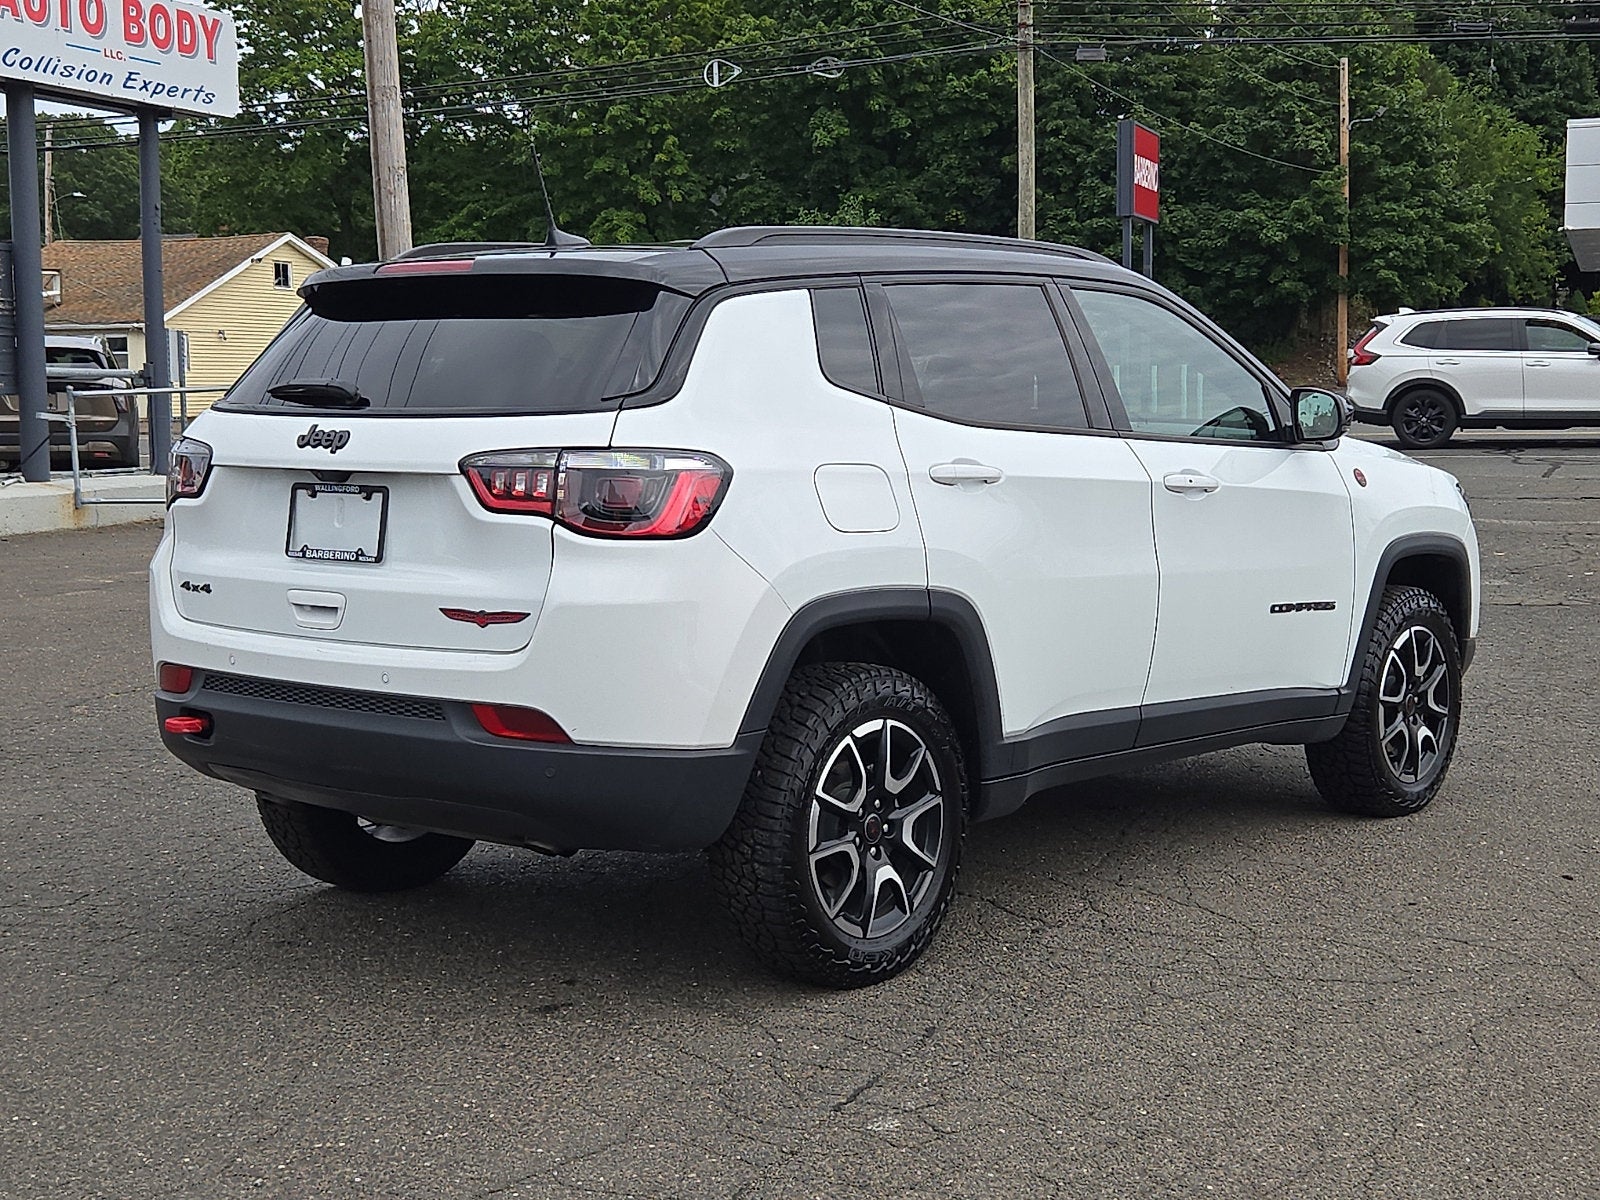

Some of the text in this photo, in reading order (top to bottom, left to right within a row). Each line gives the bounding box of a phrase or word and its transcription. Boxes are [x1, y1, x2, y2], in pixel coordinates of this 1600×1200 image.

[122, 0, 222, 64] BODY
[2, 47, 216, 104] Collision Experts
[1134, 153, 1158, 192] BARBERINO
[297, 424, 350, 454] Jeep
[305, 550, 357, 561] BARBERINO
[180, 580, 212, 594] 4x4
